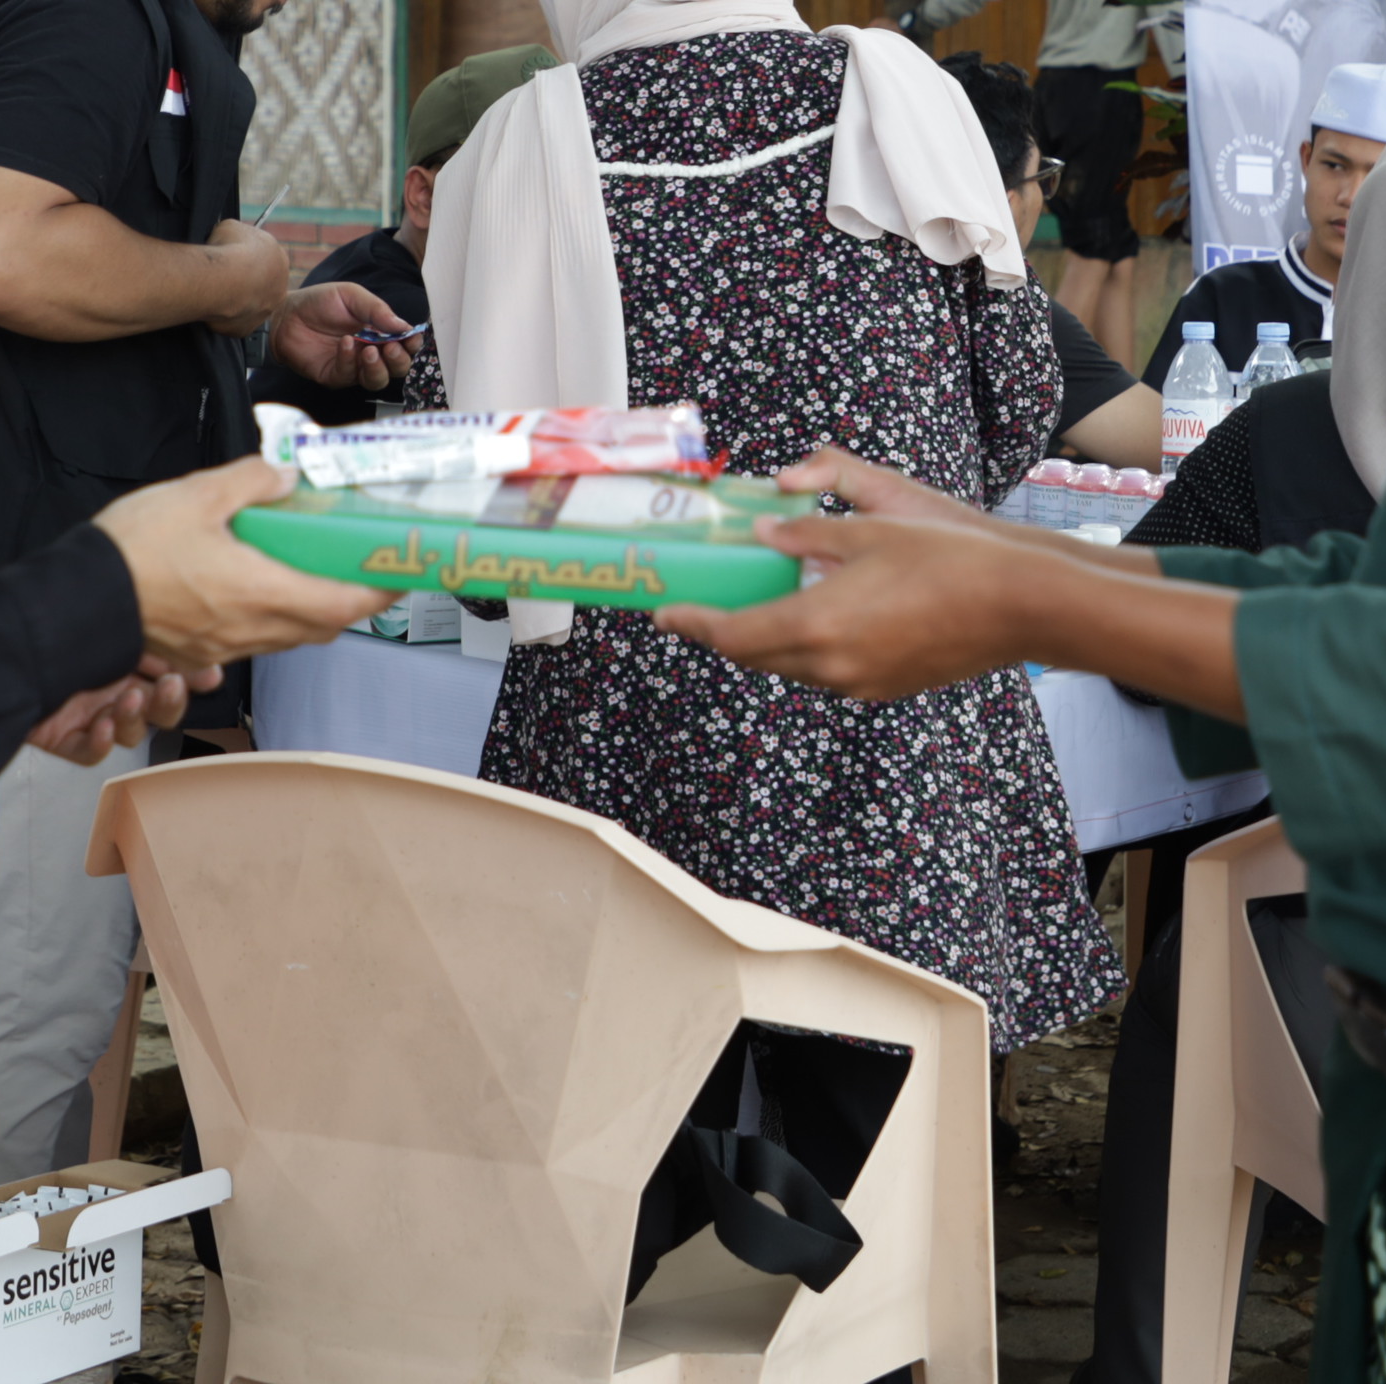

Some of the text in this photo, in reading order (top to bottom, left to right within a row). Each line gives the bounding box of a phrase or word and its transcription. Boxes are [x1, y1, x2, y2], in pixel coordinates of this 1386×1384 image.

[1244, 134, 1285, 158] ISLAM
[1259, 161, 1294, 217] BANDUNG
[3, 1246, 116, 1306] sensitive
[3, 1276, 115, 1325] MINERAL EXPERT
[63, 1299, 112, 1326] Pepsodent
